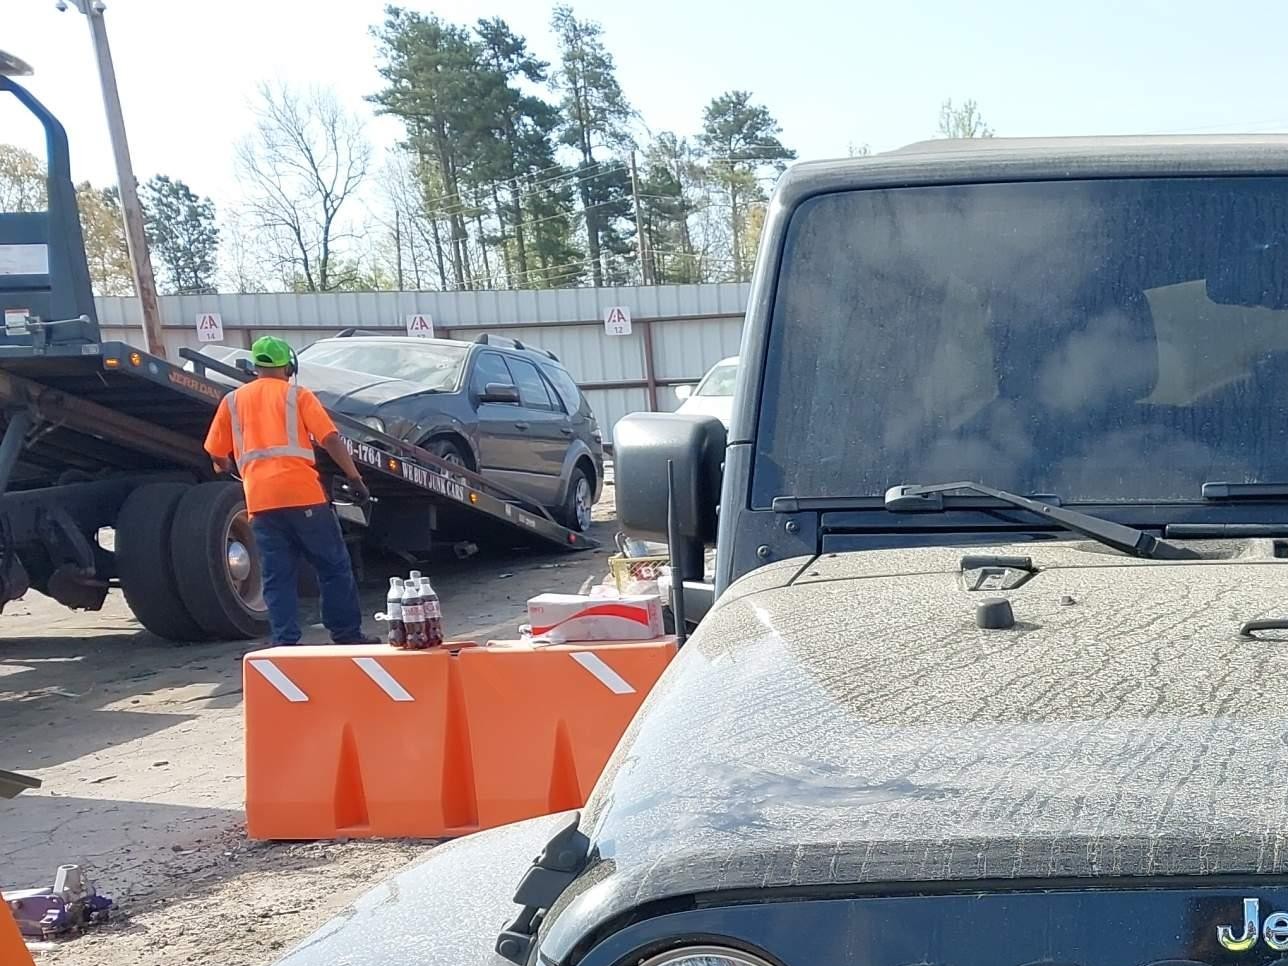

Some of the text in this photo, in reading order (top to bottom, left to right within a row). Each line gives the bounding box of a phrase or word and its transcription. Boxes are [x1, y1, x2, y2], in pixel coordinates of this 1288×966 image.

[401, 462, 414, 481] WE
[413, 466, 428, 488] BUY
[428, 473, 446, 496] JUNK
[446, 480, 464, 502] CARS
